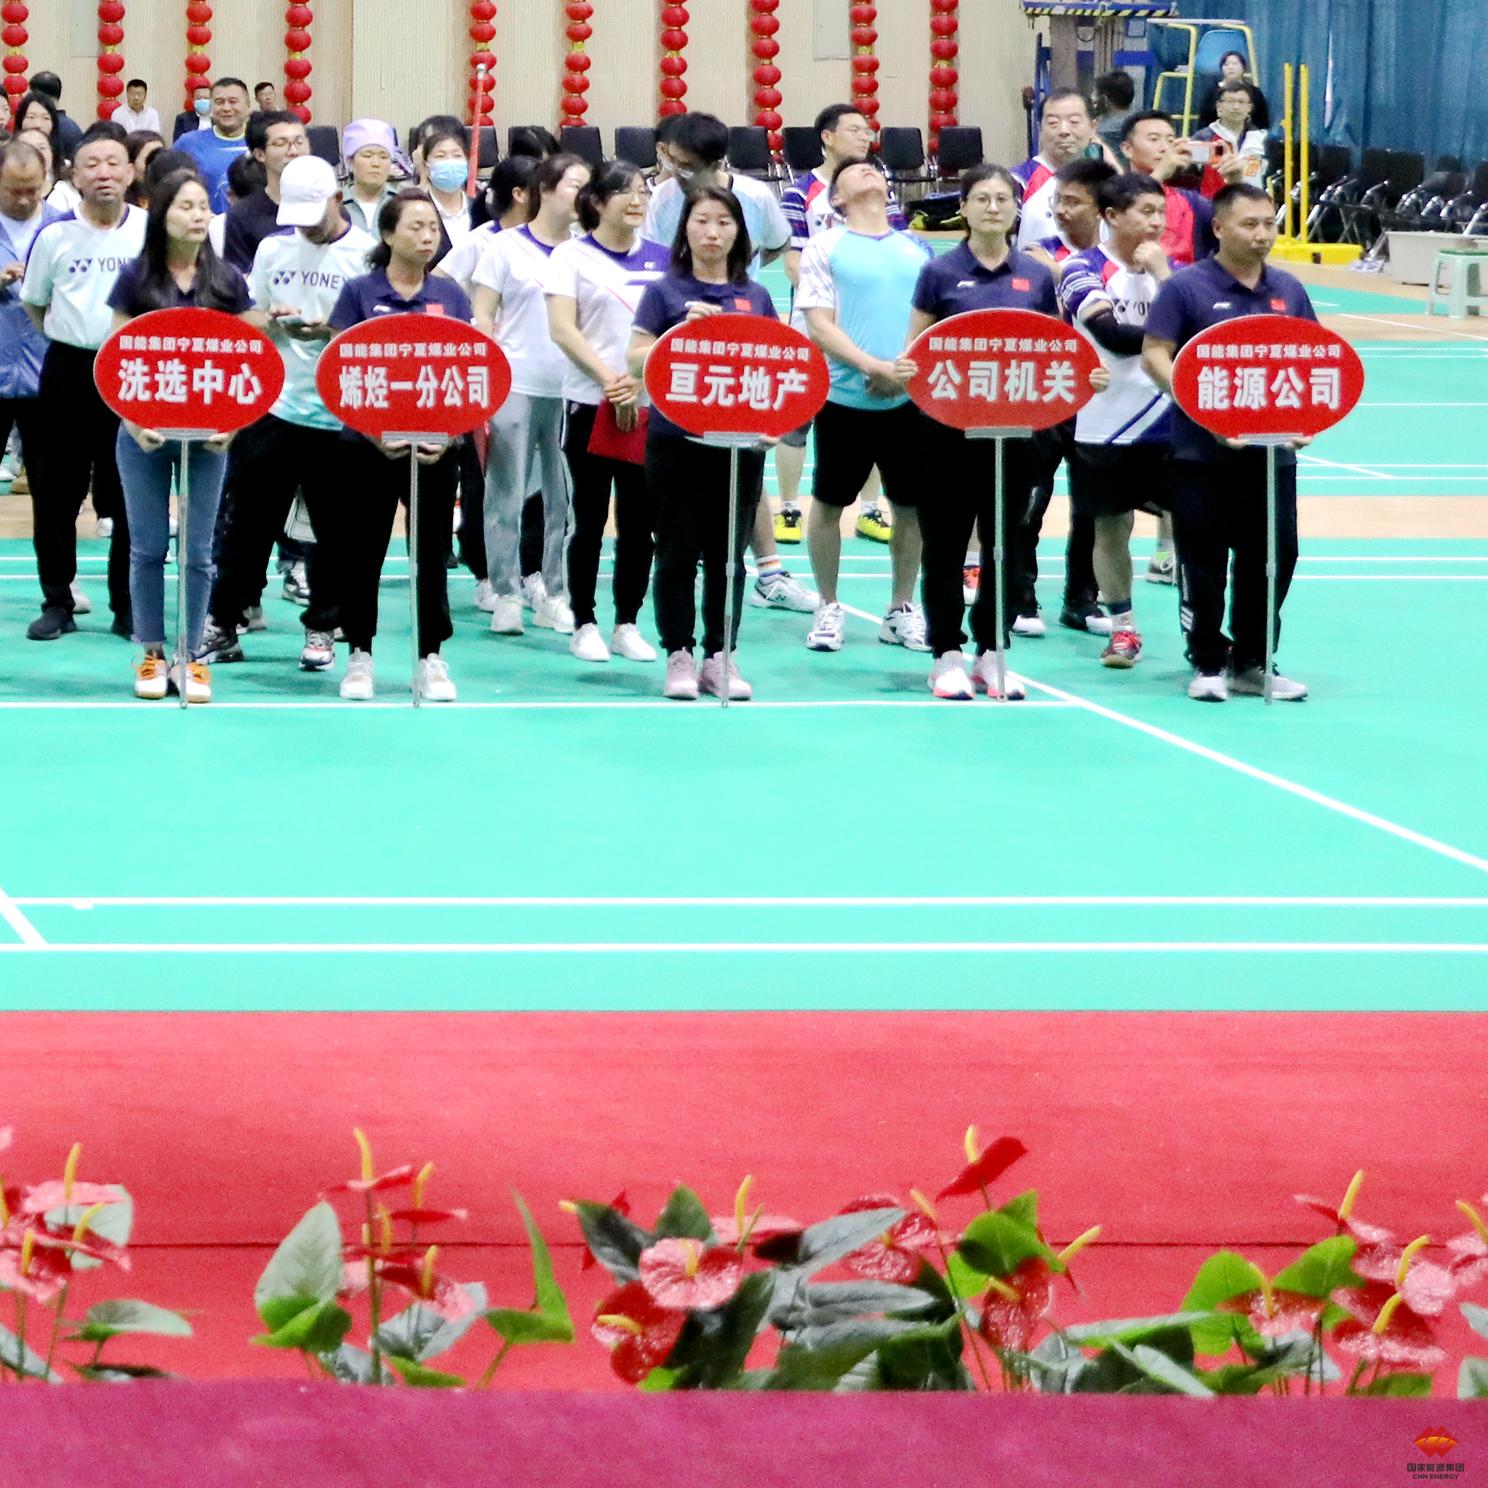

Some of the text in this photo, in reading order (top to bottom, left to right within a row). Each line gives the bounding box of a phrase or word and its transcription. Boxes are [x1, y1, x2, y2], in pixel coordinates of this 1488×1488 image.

[117, 357, 262, 405] 洗选中心
[339, 364, 490, 410] 烯烃一分公司
[665, 362, 810, 412] 亘元地产
[927, 358, 1076, 404] 公司机关
[1197, 365, 1342, 411] 能源公司
